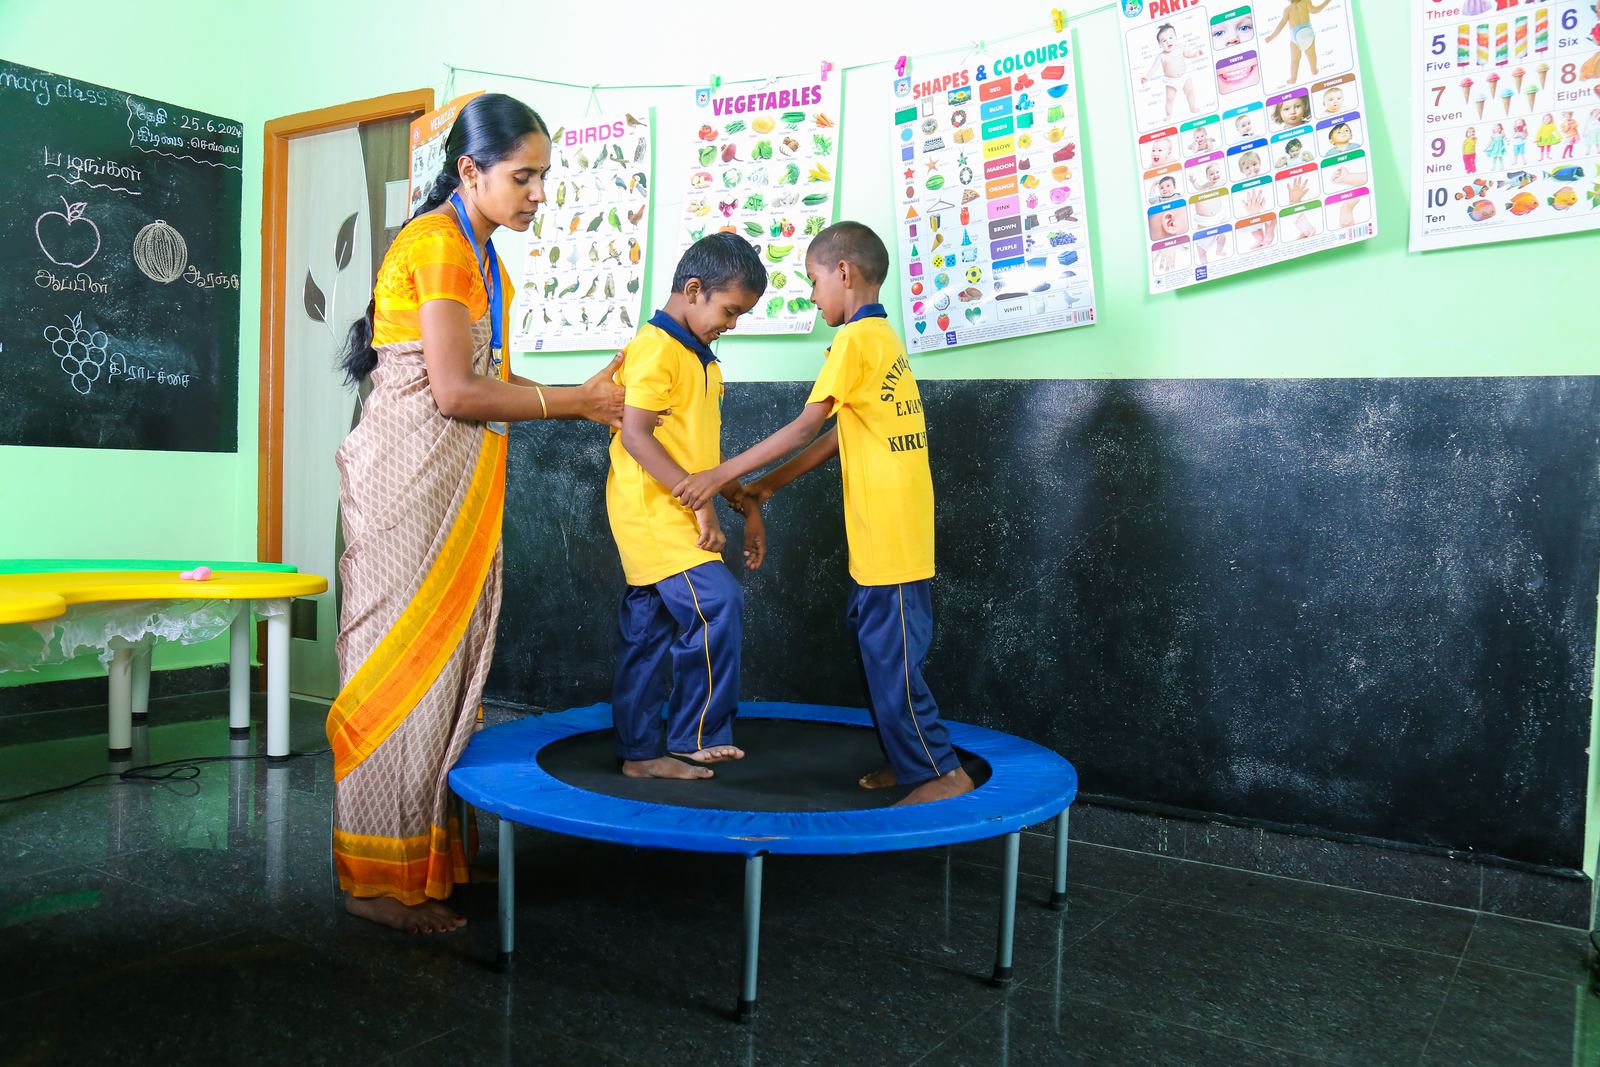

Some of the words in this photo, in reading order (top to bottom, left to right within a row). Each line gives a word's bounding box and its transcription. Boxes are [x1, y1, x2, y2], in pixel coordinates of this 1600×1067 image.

[1426, 8, 1460, 20] Three
[1561, 9, 1578, 30] 6
[1431, 34, 1446, 55] 5
[1558, 38, 1578, 48] Six
[912, 69, 969, 100] SHAPES
[975, 65, 987, 81] &
[993, 40, 1069, 76] COLOURS
[1426, 60, 1451, 71] Five
[1561, 63, 1576, 84] 8
[56, 80, 107, 106] class
[989, 86, 1001, 94] RED
[1557, 88, 1591, 101] Eight
[712, 85, 822, 116] VEGETABLES
[1431, 86, 1446, 107] 7
[989, 105, 1004, 113] BLUE
[1427, 111, 1463, 123] Seven
[565, 121, 625, 147] BIRDS
[987, 124, 1008, 133] GREEN
[988, 143, 1011, 153] YELLOW
[1431, 137, 1446, 158] 9
[986, 162, 1015, 173] MAROON
[1426, 163, 1452, 174] Nine
[989, 183, 1015, 193] ORANGE
[1427, 187, 1448, 209] 10
[1425, 214, 1446, 223] Ten
[993, 224, 1017, 232] BROWN
[996, 244, 1017, 253] PURPLE
[1003, 305, 1023, 313] WHITE
